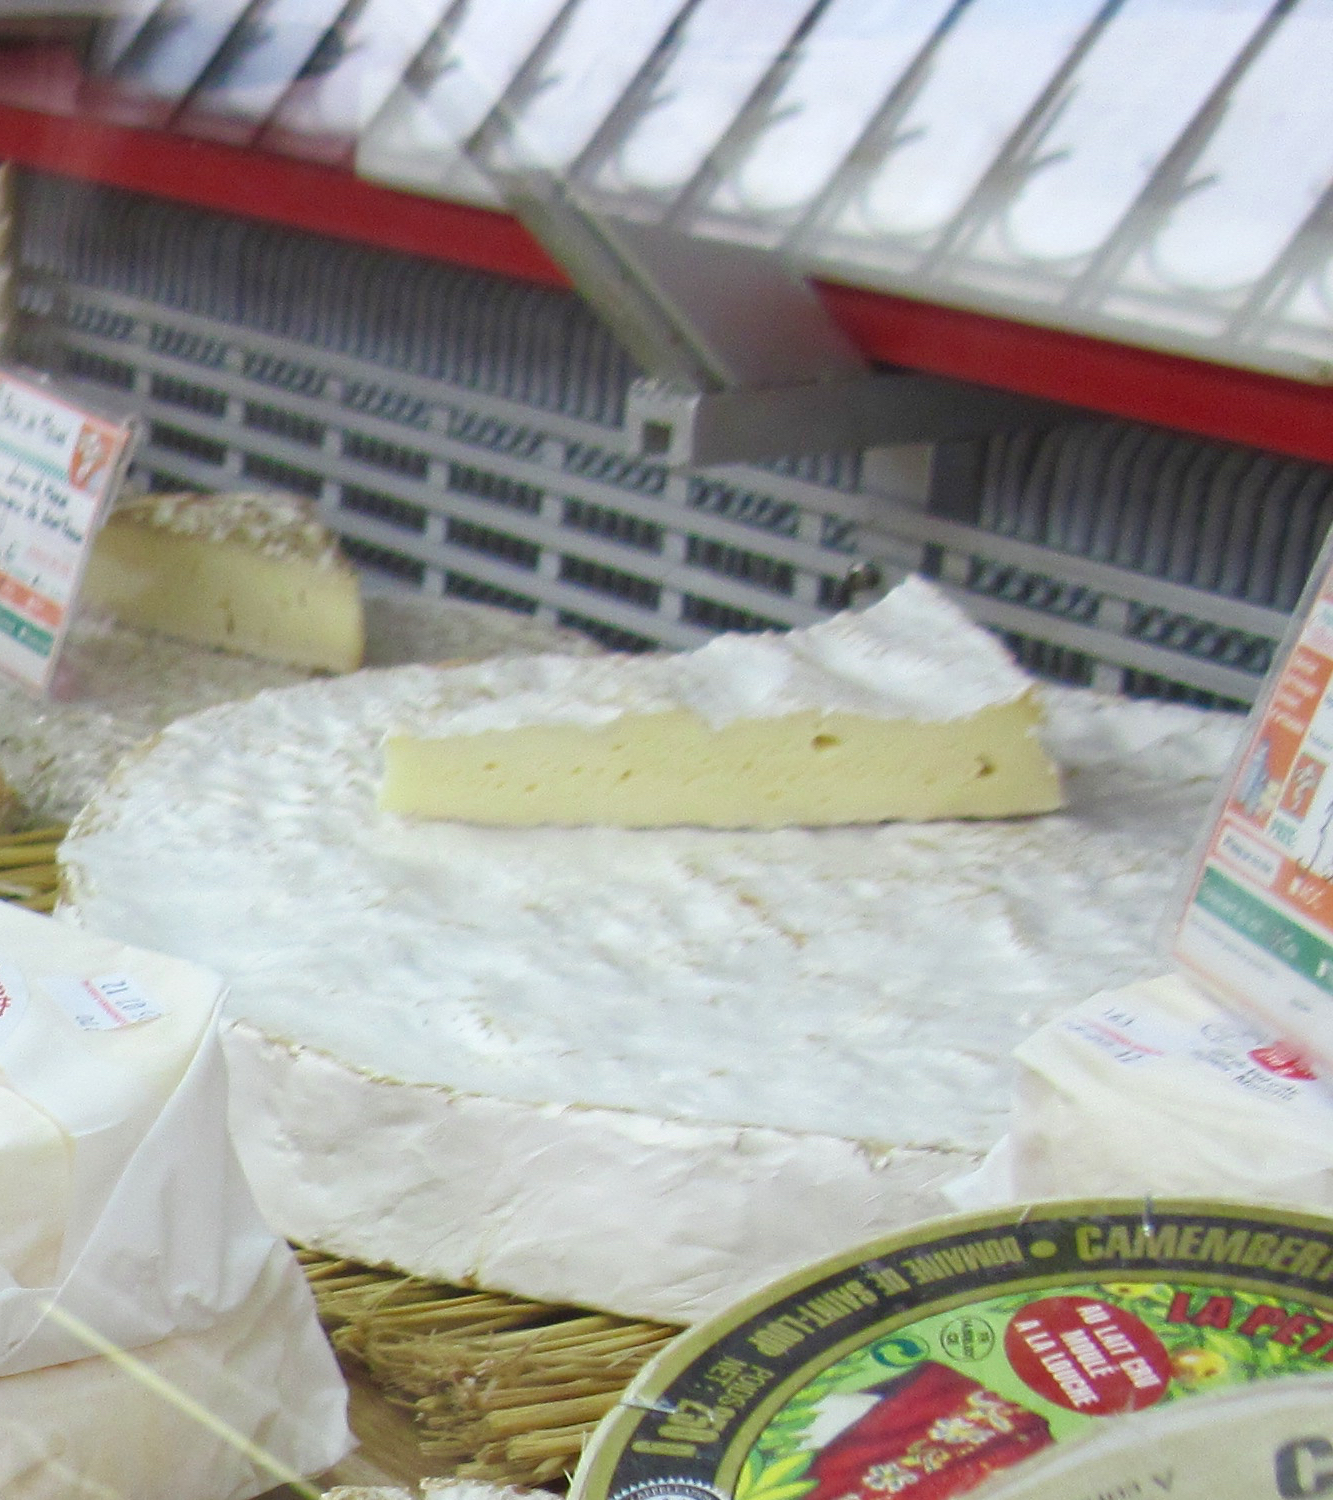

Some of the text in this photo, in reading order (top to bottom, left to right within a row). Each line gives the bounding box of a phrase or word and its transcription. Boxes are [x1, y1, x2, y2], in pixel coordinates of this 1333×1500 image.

[867, 1265, 912, 1298] DE
[900, 1234, 1026, 1287] DOMAINE
[746, 1277, 880, 1358] SAINT-LOUP
[1167, 1292, 1234, 1330] LA
[1013, 1319, 1101, 1409] A LA LOUCHE
[1059, 1328, 1118, 1379] MOULÉ
[1076, 1303, 1162, 1389] AU LAIT CRU
[1151, 1470, 1174, 1492] A
